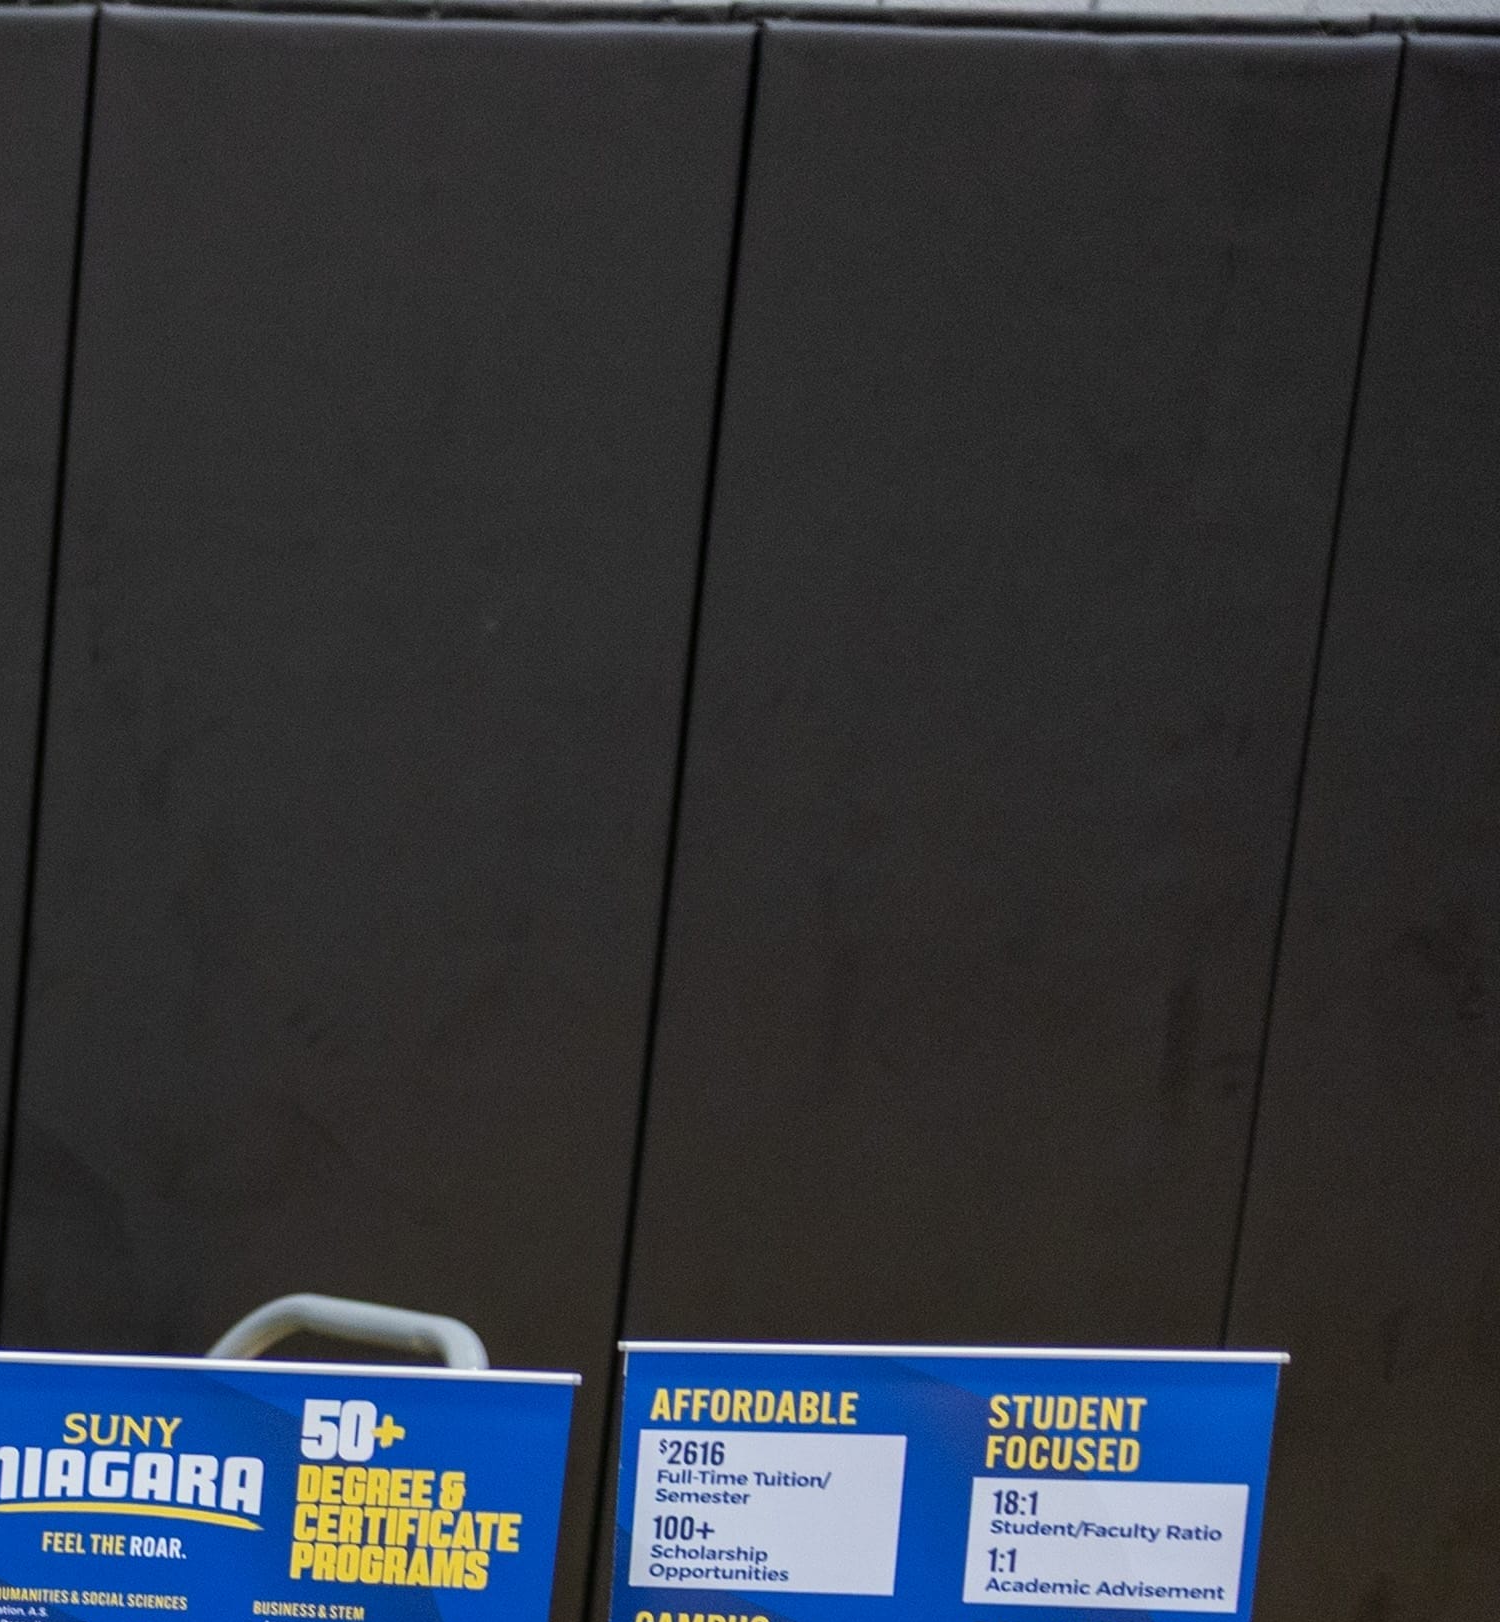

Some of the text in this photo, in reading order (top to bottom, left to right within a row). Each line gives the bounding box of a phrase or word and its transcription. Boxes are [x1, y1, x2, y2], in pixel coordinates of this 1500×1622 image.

[649, 1388, 859, 1425] AFFORDABLE
[988, 1394, 1148, 1432] STUDENT
[62, 1412, 182, 1449] SUNY
[300, 1398, 406, 1462] 50+
[659, 1438, 725, 1466] $2616
[985, 1434, 1141, 1472] FOCUSED
[296, 1464, 466, 1511] DEGREE &
[657, 1469, 832, 1490] Full-Time Tuition/
[655, 1487, 751, 1505] Semester
[993, 1489, 1038, 1516] 18:1
[293, 1503, 522, 1551] CERTIFICATE
[653, 1515, 715, 1541] 100+
[990, 1519, 1223, 1543] Student/Faculty Ratio
[41, 1531, 187, 1559] FEEL THE ROAR.
[650, 1543, 768, 1566] Scholarship
[289, 1541, 490, 1590] PROGRAMS
[648, 1562, 789, 1582] Opportunities
[988, 1547, 1017, 1573] 1:1
[69, 1590, 80, 1605] &
[81, 1590, 125, 1607] SOCIAL
[126, 1593, 188, 1611] SCIENCES
[985, 1577, 1225, 1601] Academic Advisement
[252, 1600, 365, 1621] BUSINESS & STEM
